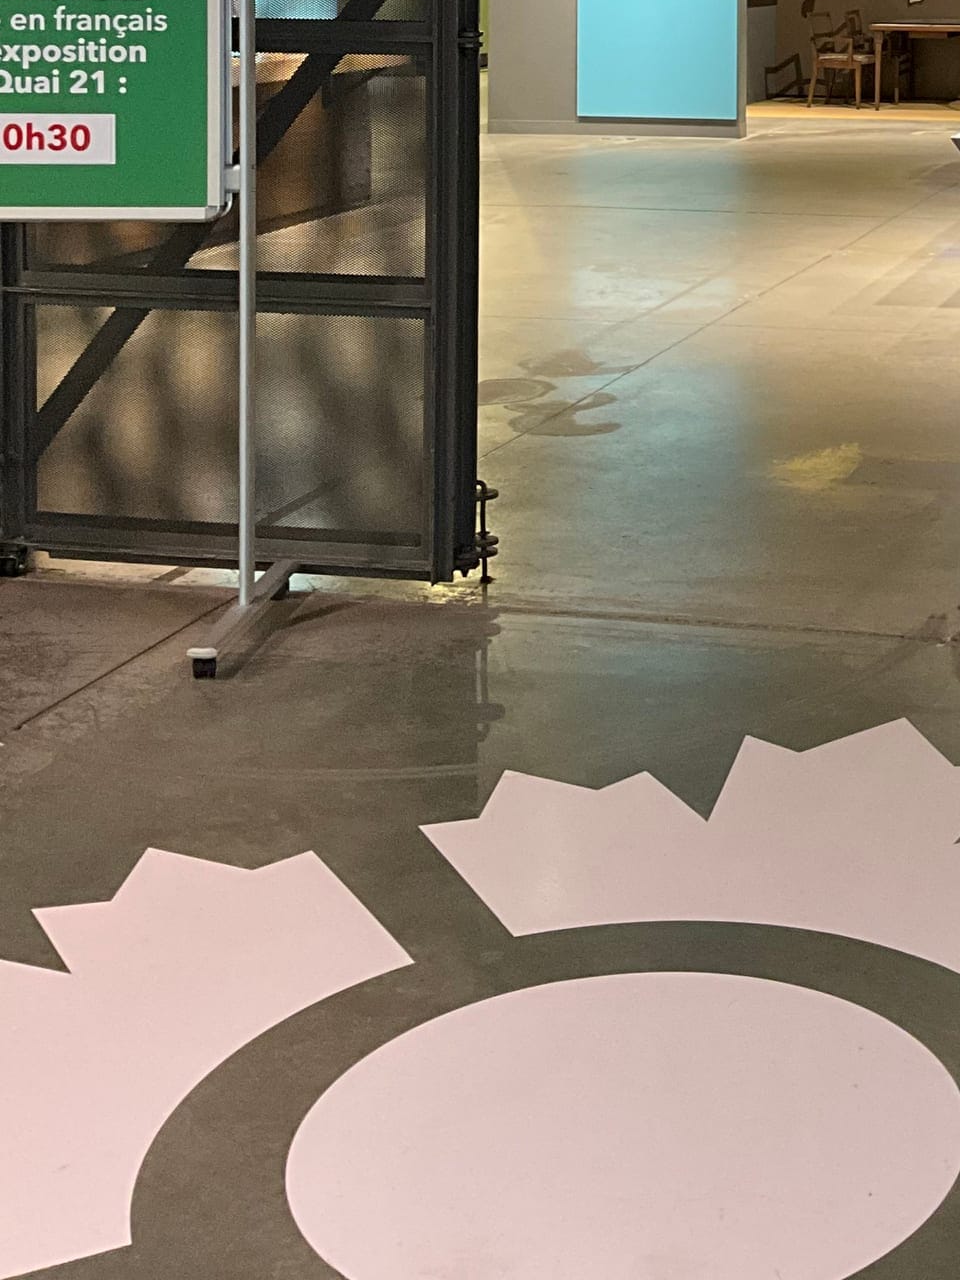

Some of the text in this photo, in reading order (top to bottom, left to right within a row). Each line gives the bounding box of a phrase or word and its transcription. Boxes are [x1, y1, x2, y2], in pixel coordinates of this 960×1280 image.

[10, 5, 168, 39] en français
[0, 38, 147, 70] xposition
[69, 70, 105, 94] 21
[3, 122, 91, 152] 0h30
